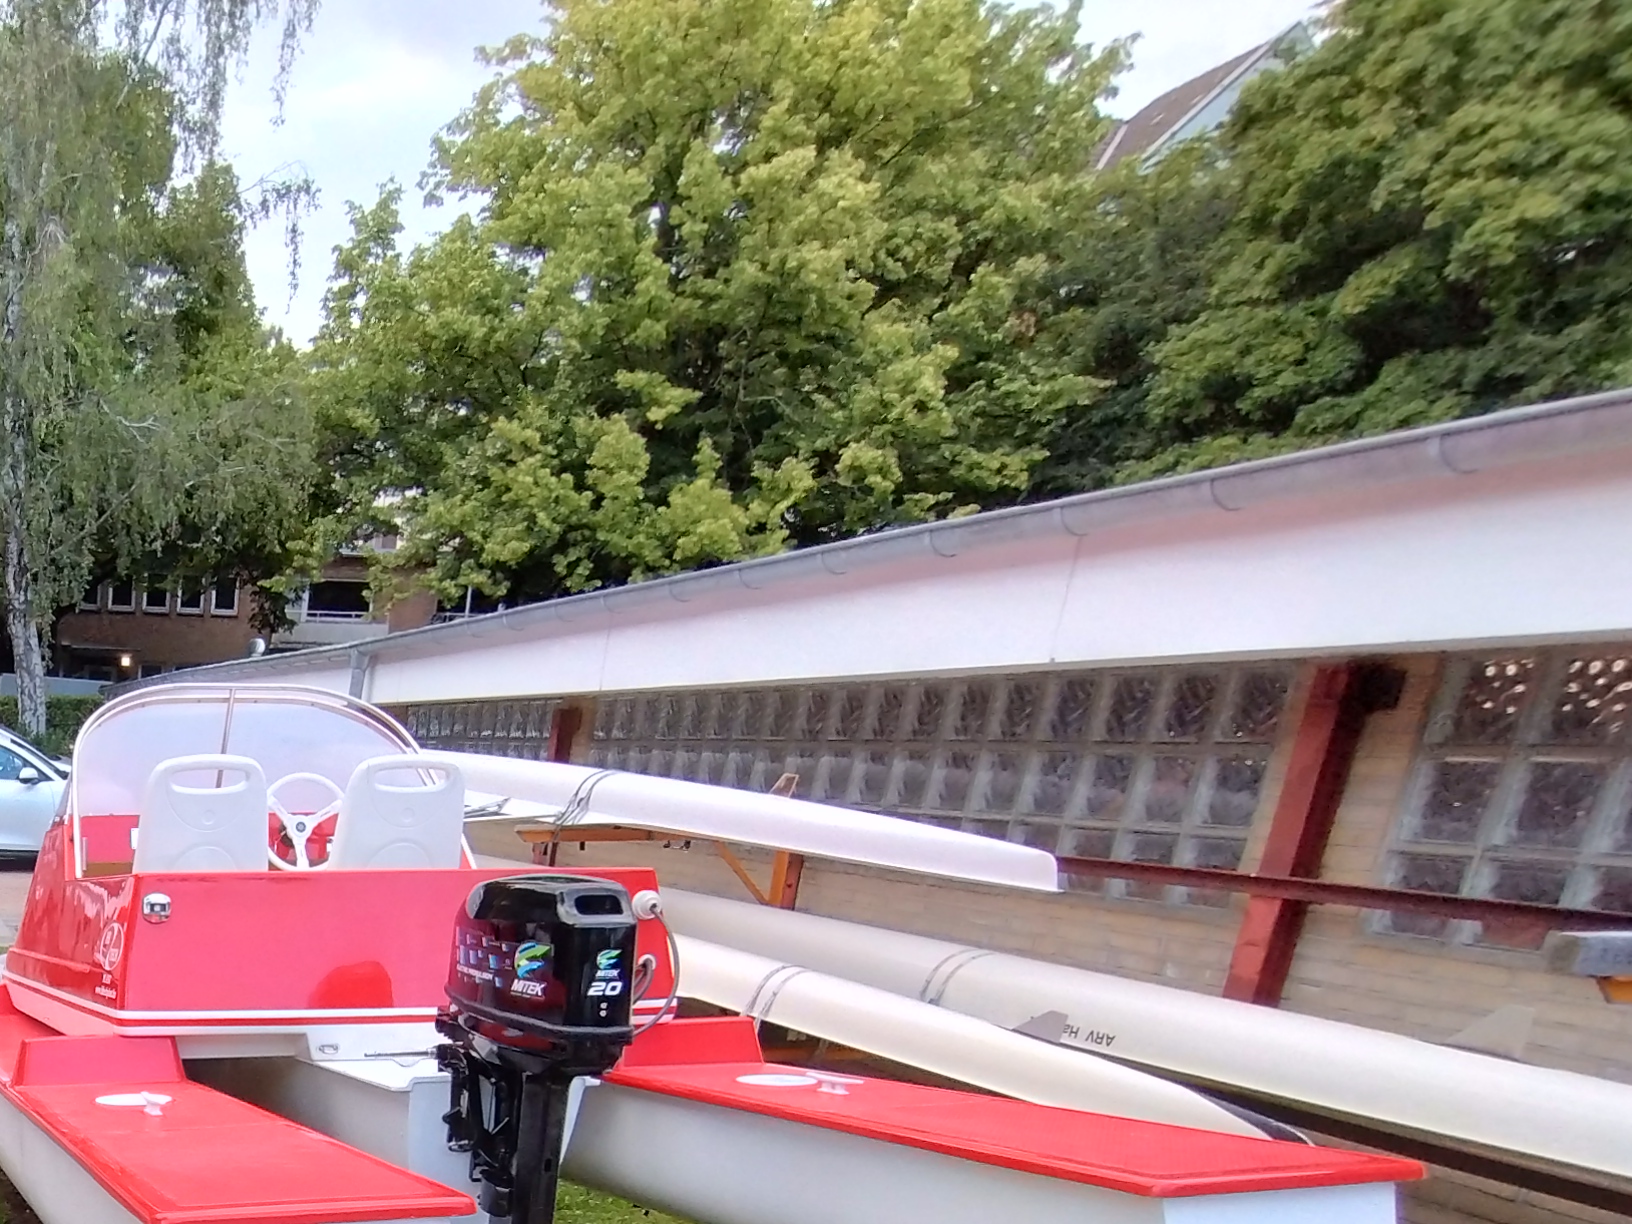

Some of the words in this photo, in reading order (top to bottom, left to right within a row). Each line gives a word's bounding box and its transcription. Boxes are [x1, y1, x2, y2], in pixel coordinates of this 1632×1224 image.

[510, 979, 547, 996] MITEK
[587, 981, 623, 996] 20
[1084, 1030, 1116, 1047] ARV
